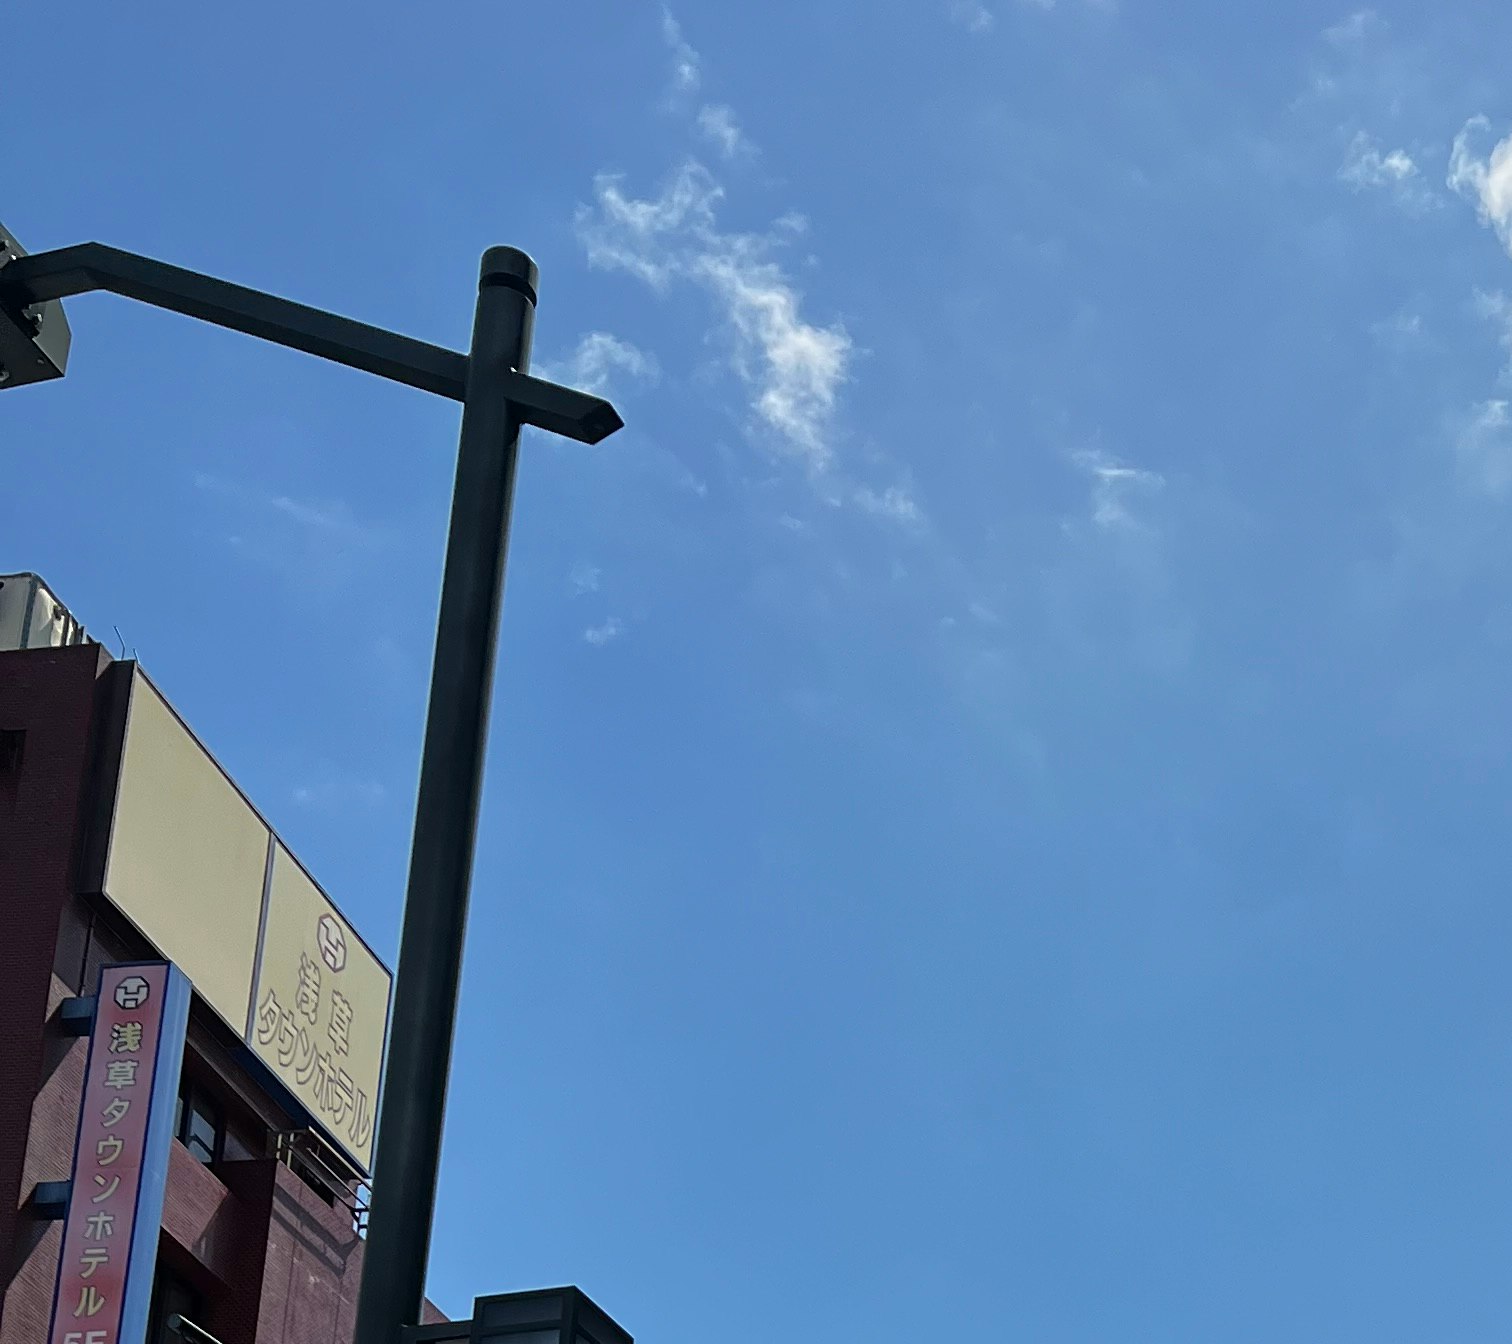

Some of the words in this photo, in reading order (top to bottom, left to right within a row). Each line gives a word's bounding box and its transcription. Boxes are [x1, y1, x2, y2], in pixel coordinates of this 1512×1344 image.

[257, 988, 371, 1149] タウンホテル
[296, 952, 353, 1057] 浅草
[73, 1021, 143, 1318] 浅草タウンホテル
